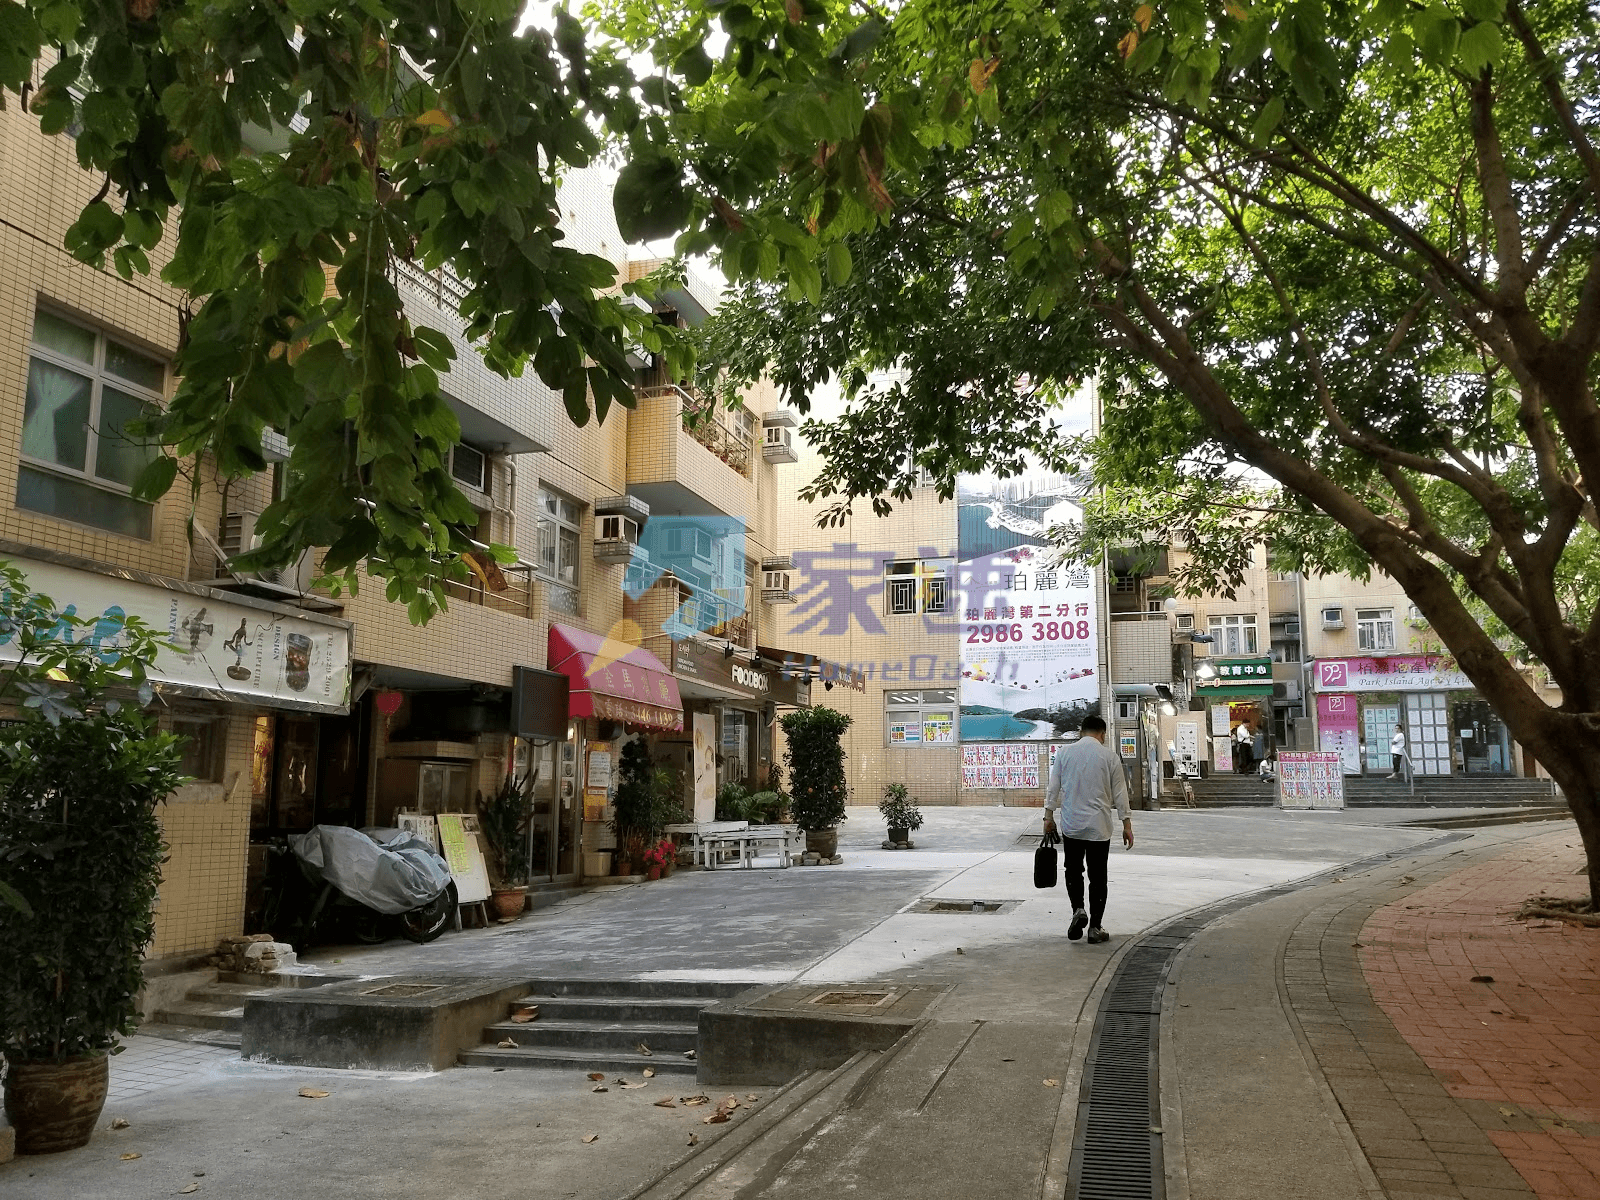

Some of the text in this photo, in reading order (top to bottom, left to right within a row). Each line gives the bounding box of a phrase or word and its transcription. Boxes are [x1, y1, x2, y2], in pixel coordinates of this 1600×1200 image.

[1004, 568, 1090, 591] 珀麗灣
[966, 603, 1089, 621] 珀麗灣第二分行
[273, 625, 282, 660] DESIGN
[967, 620, 1090, 644] 2986 3808
[253, 632, 264, 689] SCULPTURE
[1215, 664, 1267, 676] 教育中心
[731, 664, 769, 692] FOODBOX
[1359, 677, 1383, 688] Park
[1385, 675, 1414, 687] Island
